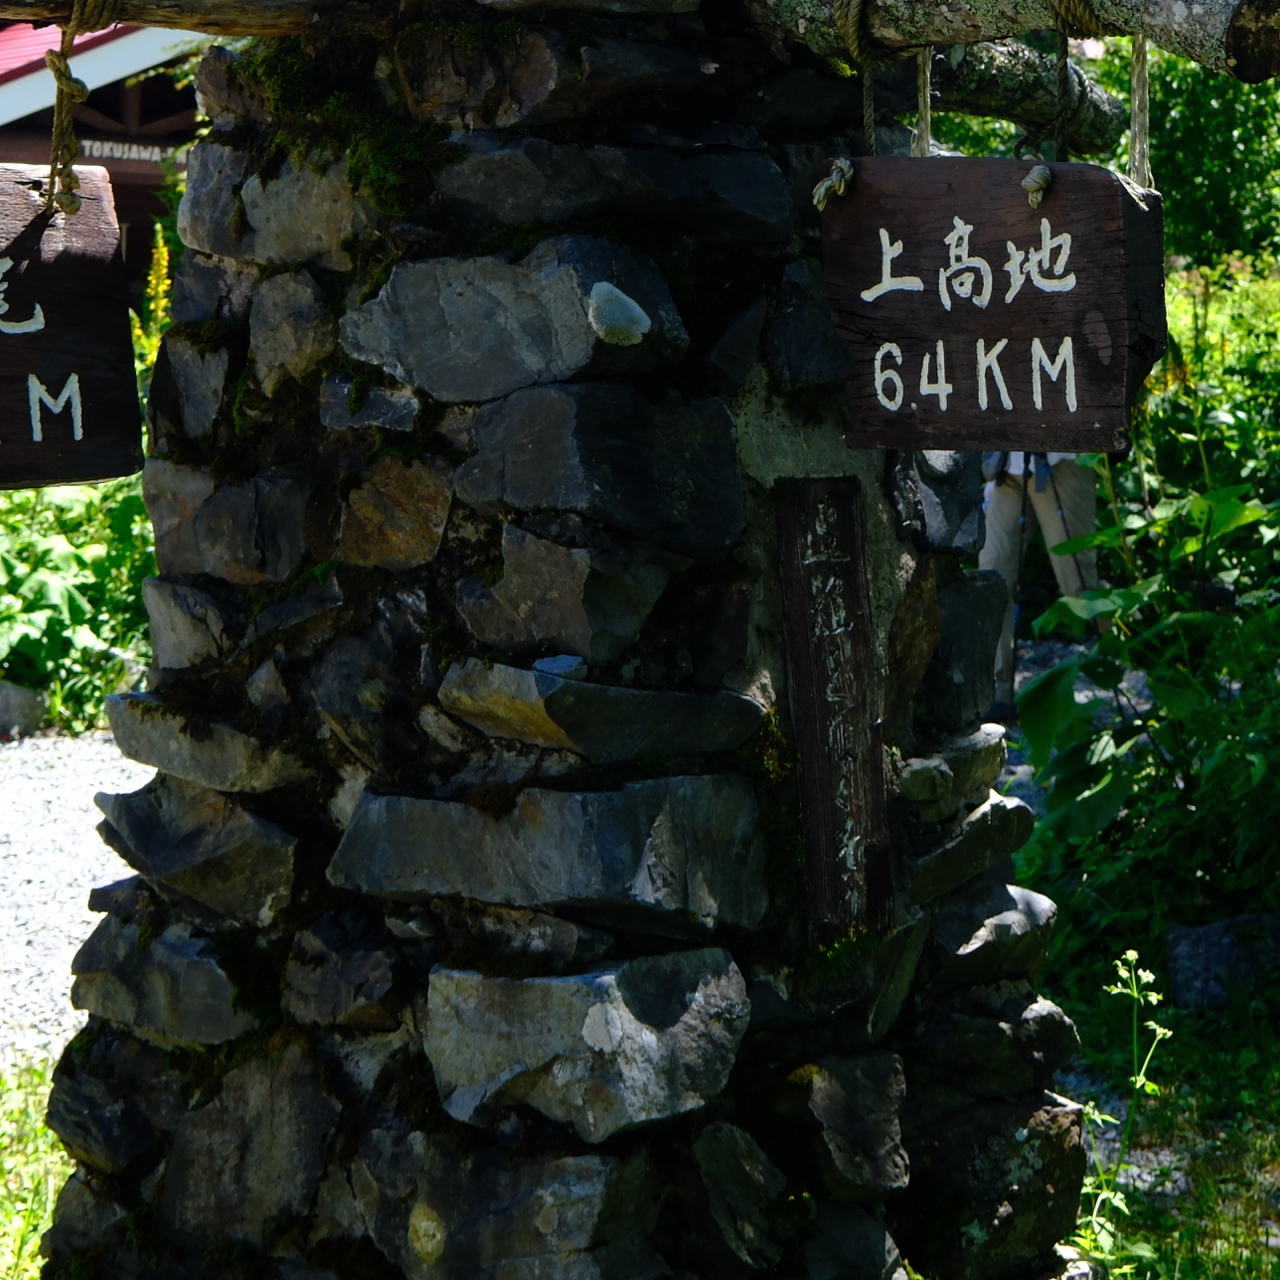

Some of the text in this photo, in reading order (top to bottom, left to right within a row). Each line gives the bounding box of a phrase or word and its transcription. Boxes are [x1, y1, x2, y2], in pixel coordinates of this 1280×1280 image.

[860, 215, 1077, 311] 上高地
[874, 336, 1078, 413] 6.4 KM
